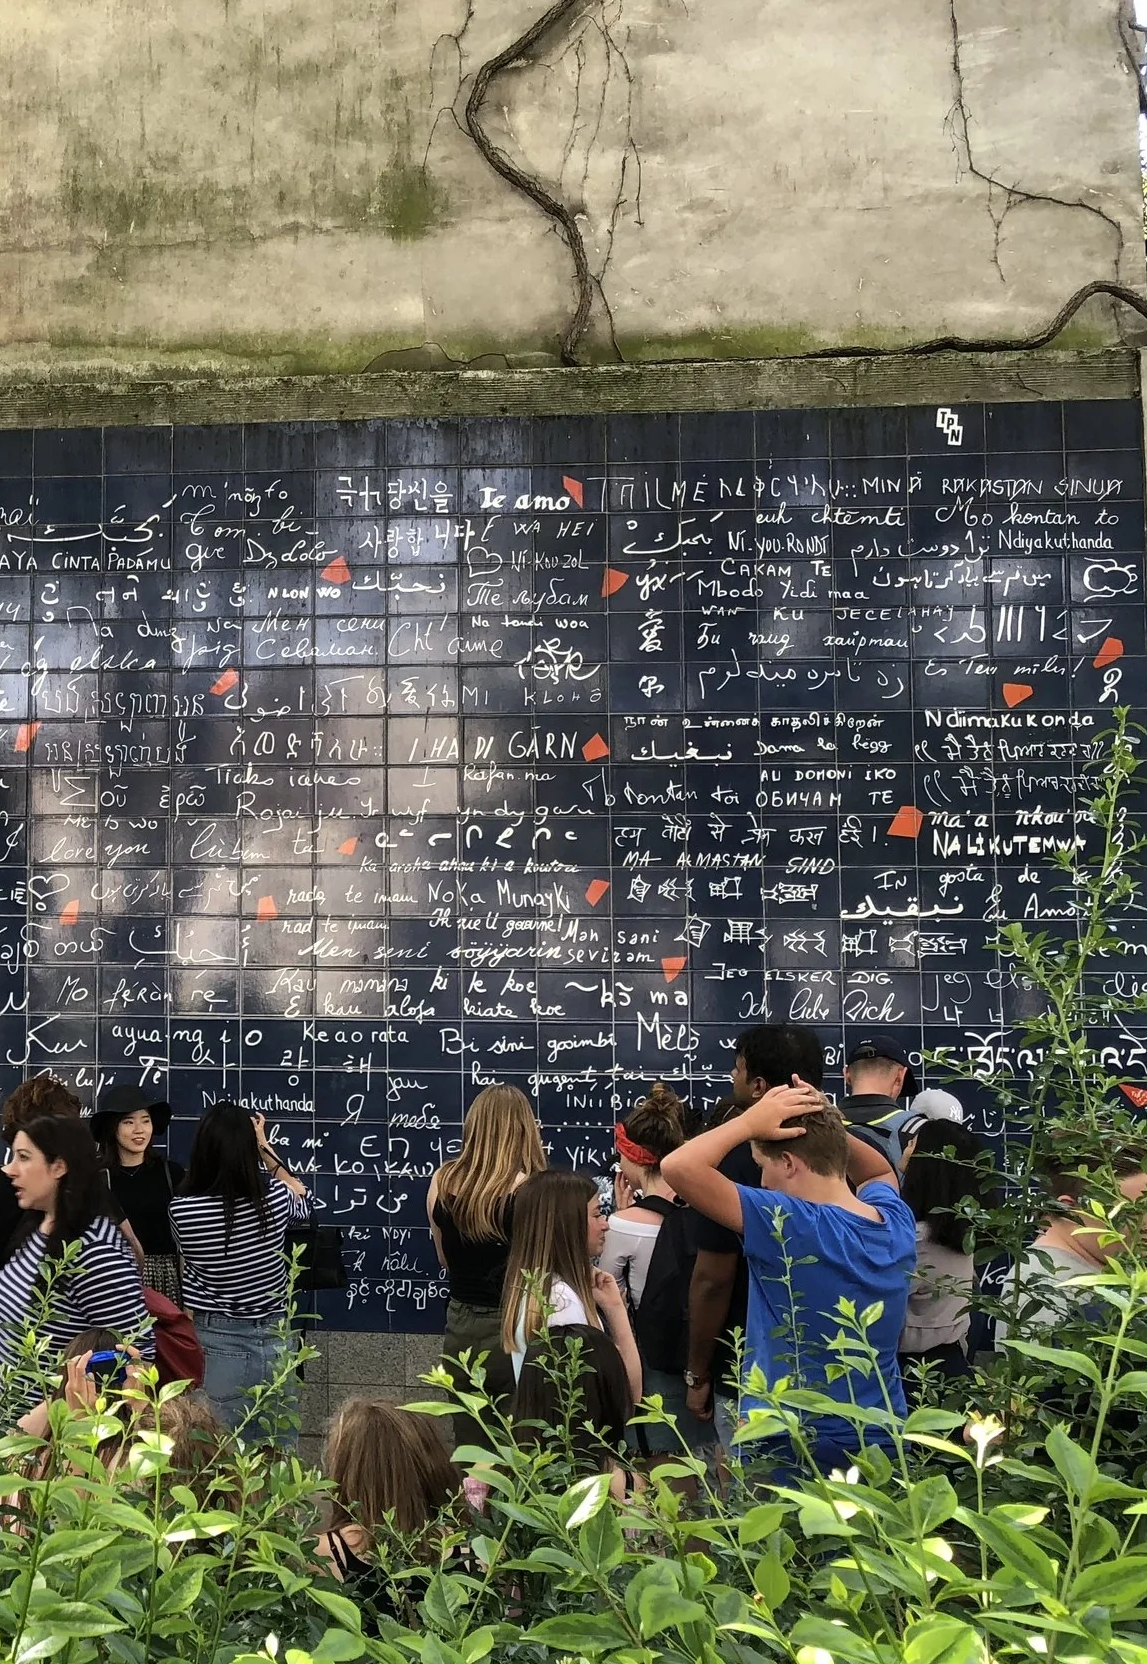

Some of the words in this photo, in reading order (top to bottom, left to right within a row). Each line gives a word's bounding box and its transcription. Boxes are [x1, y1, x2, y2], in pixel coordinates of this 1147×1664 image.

[936, 408, 964, 446] TPN
[478, 486, 504, 510] Te
[514, 487, 571, 511] amo
[1004, 503, 1080, 525] kontan
[1095, 505, 1119, 526] to
[998, 530, 1114, 556] Ndiyakuthanda
[370, 1024, 409, 1043] rata
